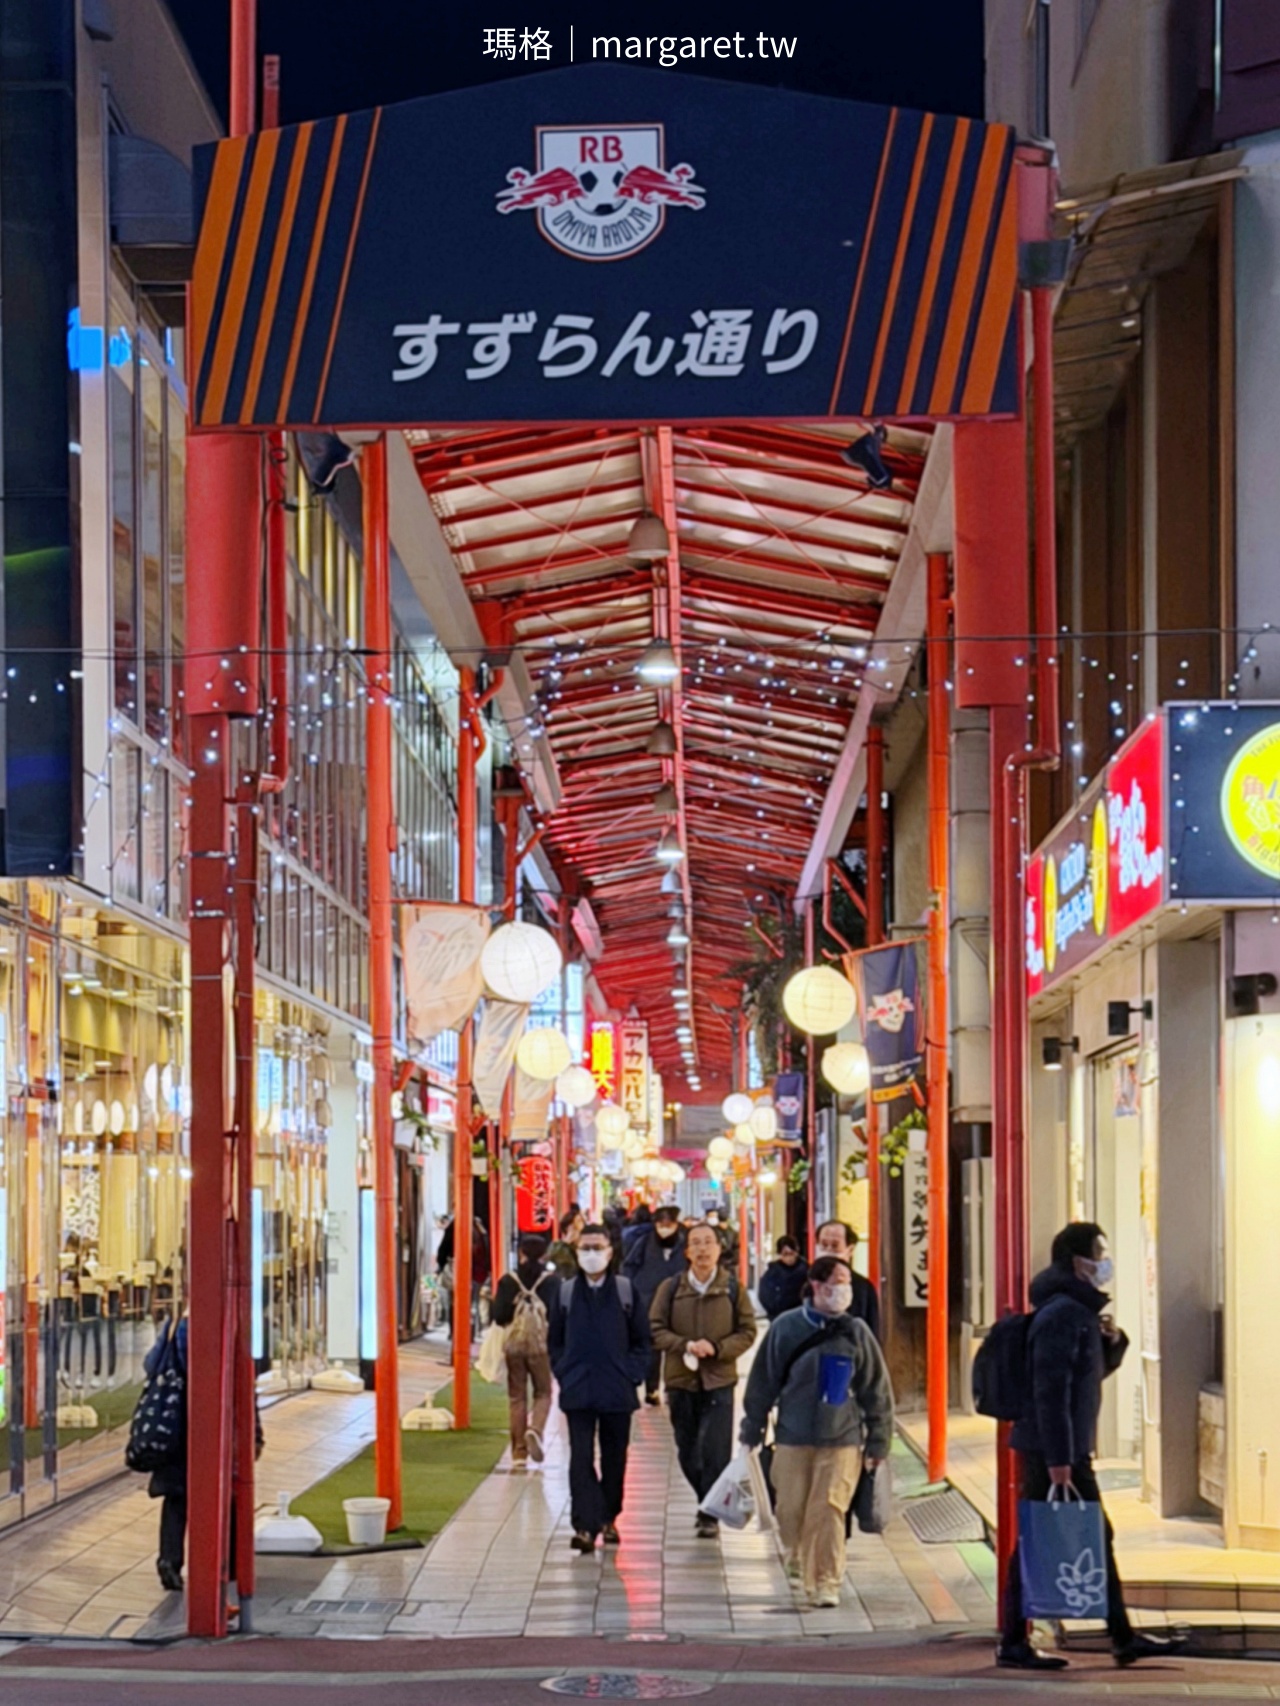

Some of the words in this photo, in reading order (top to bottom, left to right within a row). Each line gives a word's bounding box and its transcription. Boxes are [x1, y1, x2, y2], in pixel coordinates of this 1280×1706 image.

[579, 135, 624, 163] RB
[551, 209, 598, 249] OMIYA
[602, 206, 654, 249] ARDIJA
[392, 308, 819, 381] すずらん通り
